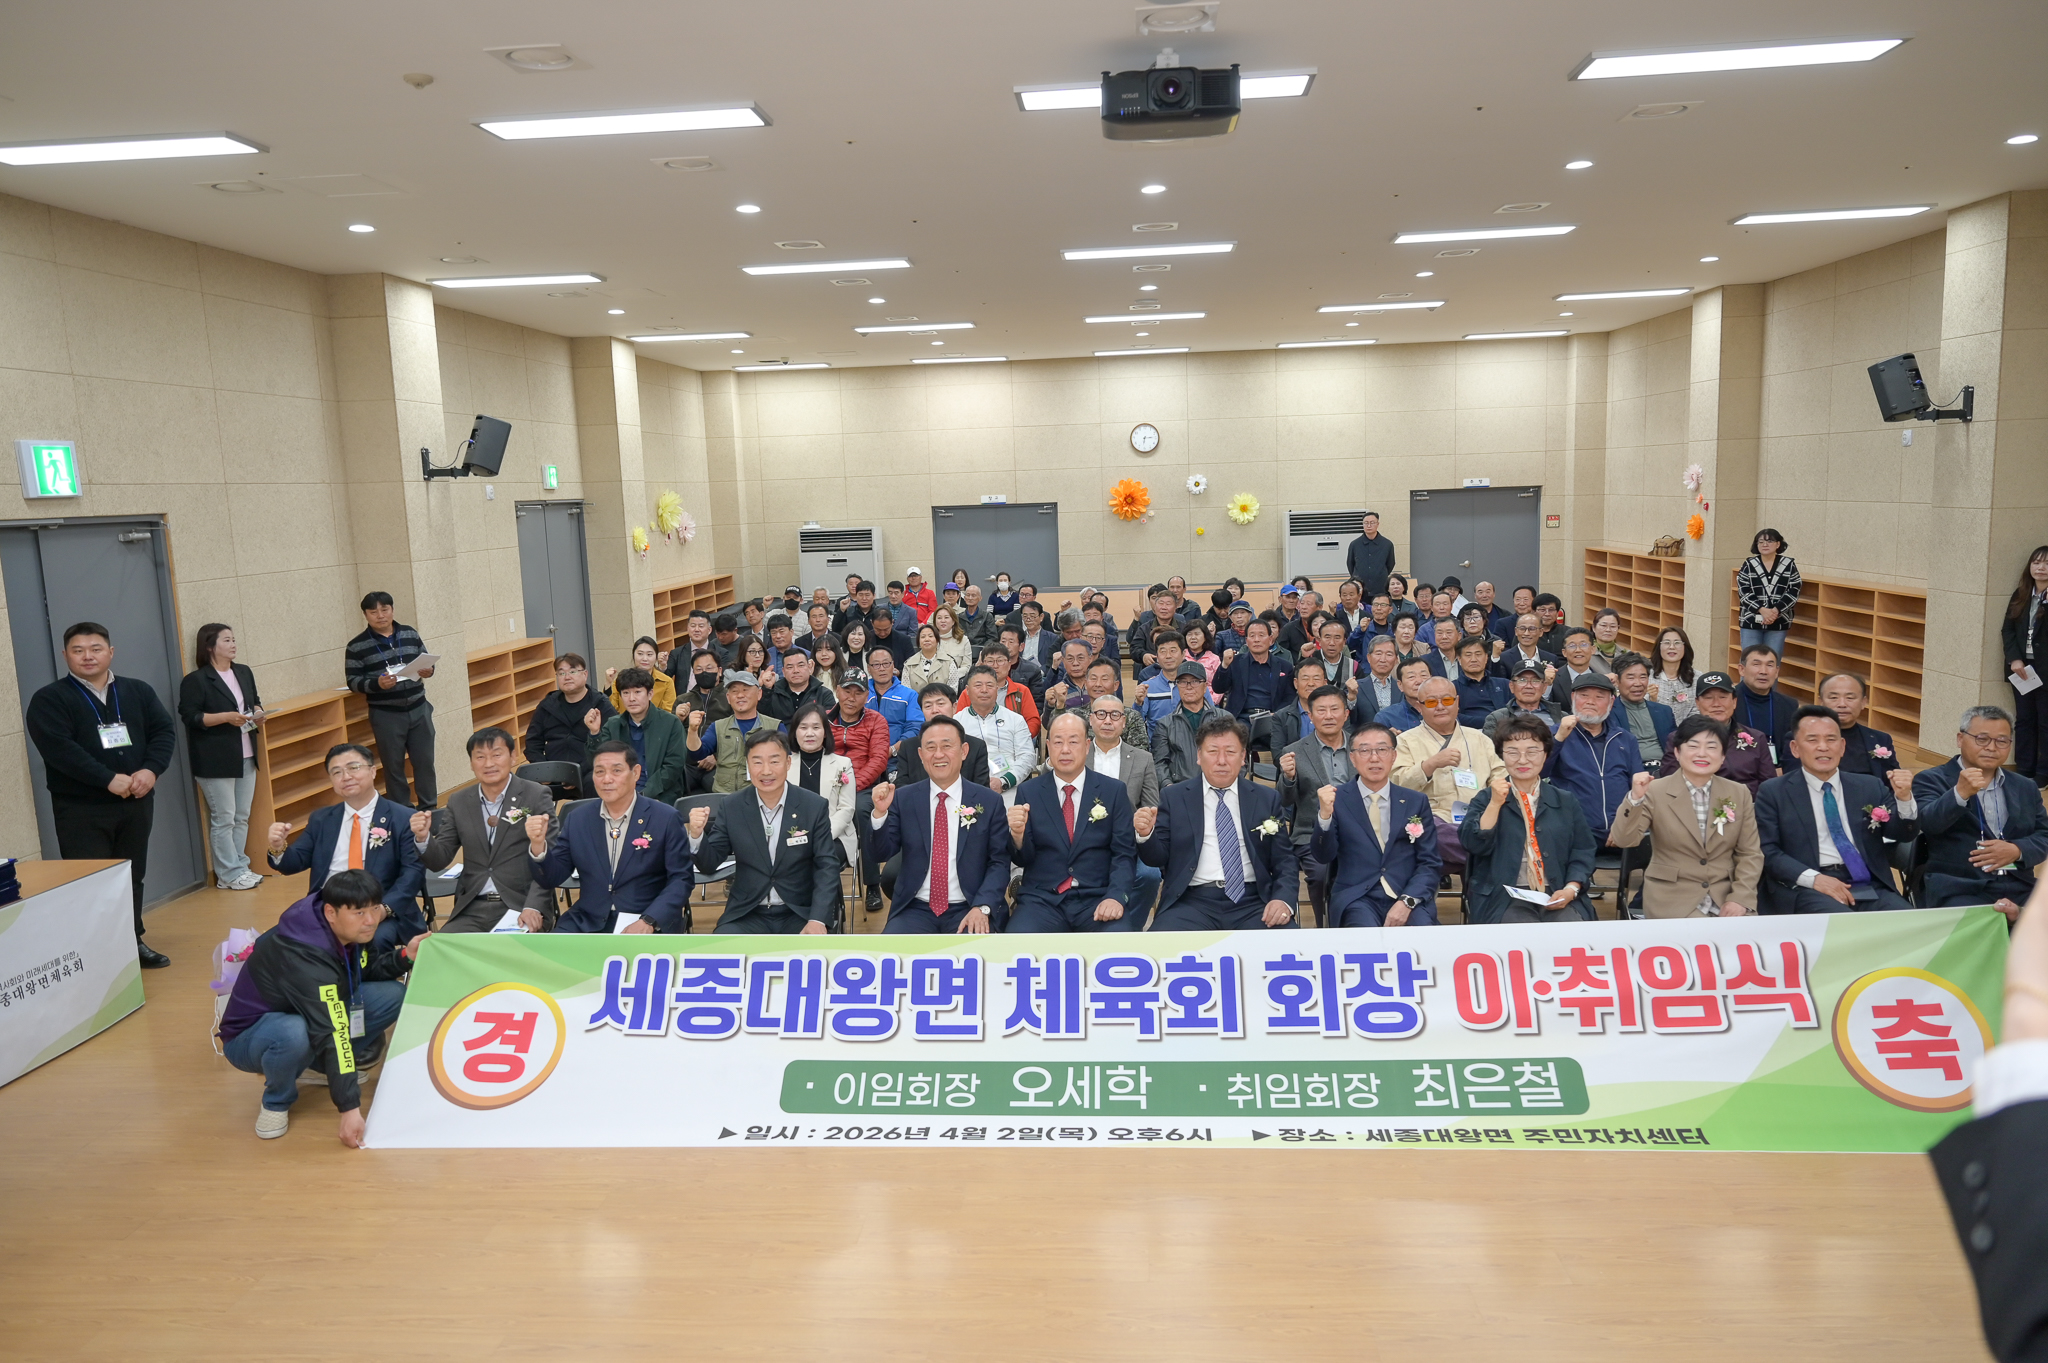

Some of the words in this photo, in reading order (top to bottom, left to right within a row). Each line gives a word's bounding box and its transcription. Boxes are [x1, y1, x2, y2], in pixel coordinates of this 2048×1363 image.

[588, 956, 980, 1037] 세종대왕면
[1003, 953, 1240, 1036] 체육회
[1263, 951, 1429, 1035] 회장
[1452, 941, 1813, 1030] 이·취임식
[462, 1011, 539, 1084] 경
[1871, 998, 1964, 1082] 축
[833, 1071, 981, 1108] 이임회장
[1009, 1065, 1152, 1110] 오세학
[1226, 1071, 1381, 1109] 취임회장
[1411, 1061, 1565, 1110] 최은철
[744, 1125, 800, 1141] 일시
[823, 1125, 932, 1141] 2026년
[939, 1126, 989, 1141] 4월
[996, 1126, 1099, 1142] 2일(목)
[1107, 1126, 1214, 1142] 오후6시
[1278, 1127, 1338, 1143] 장소
[1364, 1127, 1516, 1144] 세종대왕면
[1523, 1127, 1711, 1146] 주민자치센터
